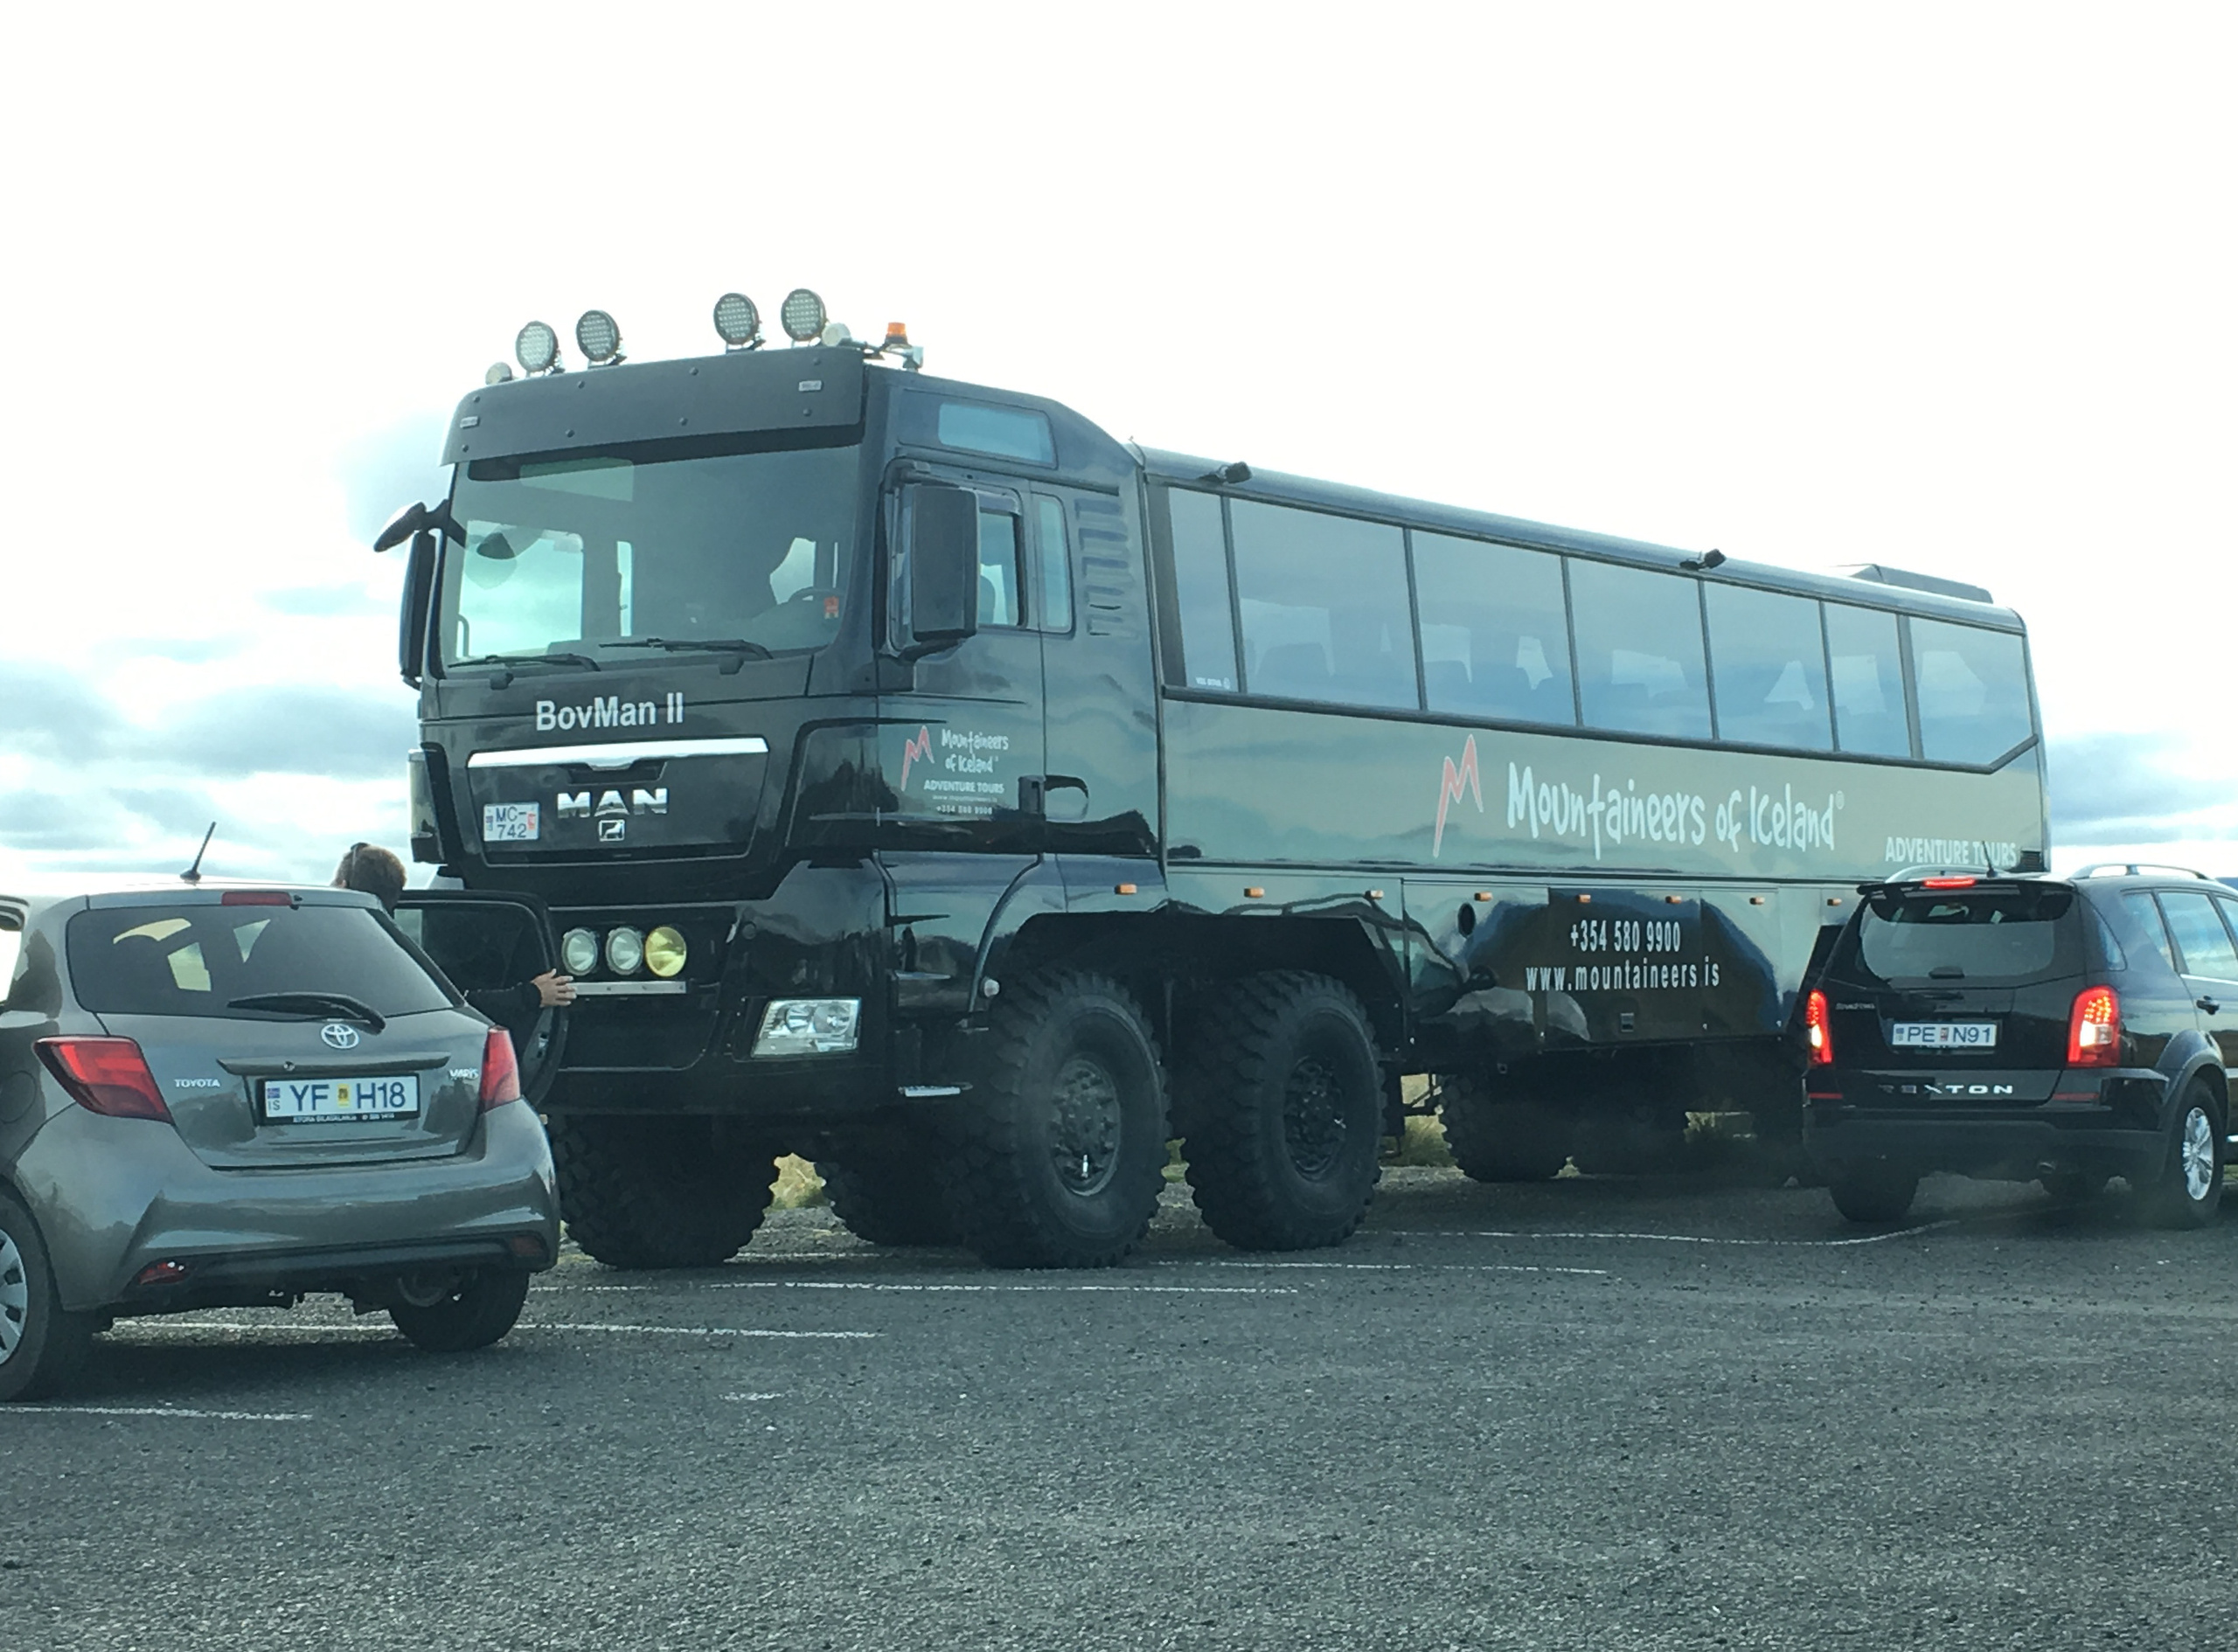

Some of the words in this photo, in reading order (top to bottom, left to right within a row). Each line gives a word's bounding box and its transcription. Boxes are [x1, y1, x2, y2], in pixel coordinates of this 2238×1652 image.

[536, 696, 656, 731] BovMan
[667, 692, 684, 724] II
[942, 728, 1009, 754] Mountaineers
[945, 753, 956, 773] of
[958, 753, 993, 773] Iceland
[924, 780, 976, 793] ADVENTURE
[977, 782, 1004, 794] TOURS
[557, 788, 668, 818] MAN
[1507, 762, 1706, 861] Mountaineers
[1716, 790, 1742, 852] of
[1750, 783, 1834, 852] Iceland
[497, 823, 526, 839] 742
[1885, 836, 1969, 864] ADVENTURE
[1972, 841, 2018, 867] TOURS
[1571, 920, 1607, 952] +354
[1614, 920, 1640, 952] 580
[1646, 921, 1680, 952] 9900
[1908, 1026, 1936, 1043] PE
[1953, 1027, 1991, 1043] N91
[174, 1079, 221, 1088] TOYOTA
[289, 1084, 330, 1112] YF
[356, 1081, 406, 1109] H18
